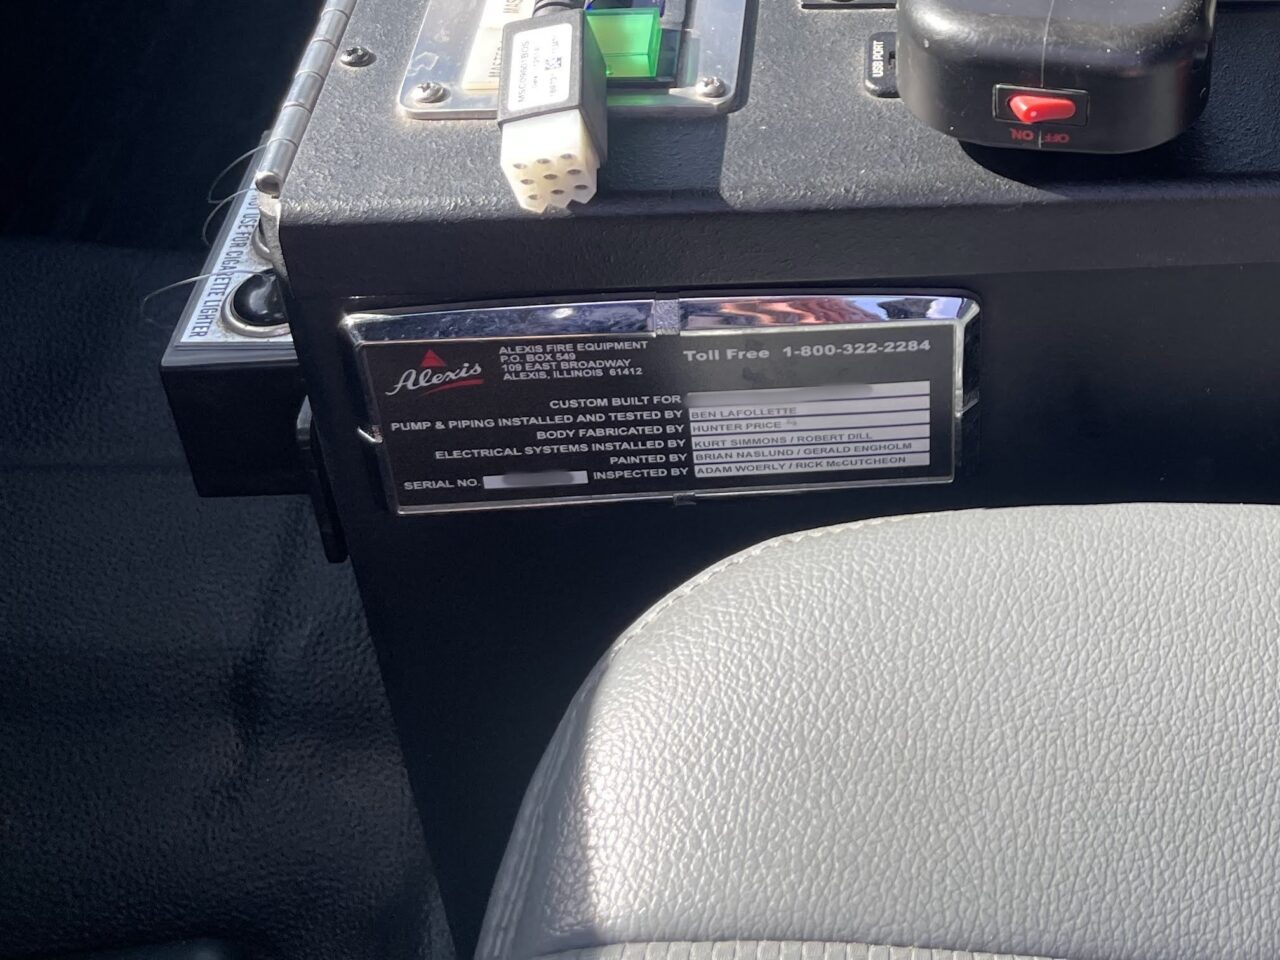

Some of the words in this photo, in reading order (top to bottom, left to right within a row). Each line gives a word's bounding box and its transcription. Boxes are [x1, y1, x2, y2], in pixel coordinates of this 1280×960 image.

[872, 40, 883, 59] PORT
[872, 61, 883, 78] USB
[207, 248, 243, 297] CIGARETTE
[189, 298, 221, 337] LIGHTER
[499, 345, 543, 354] ALEXIS
[546, 343, 574, 353] FIRE
[577, 340, 648, 351] EQUIPMENT
[683, 349, 719, 362] Toll
[726, 348, 770, 360] Free
[782, 339, 931, 358] 1-800-322-2284
[502, 363, 523, 371] 109
[525, 361, 559, 371] EAST
[562, 359, 631, 369] BROADWAY
[526, 352, 553, 362] BOX
[385, 362, 481, 396] Alexis
[503, 371, 550, 381] ALEXIS,
[553, 369, 603, 379] ILLINOIS
[609, 367, 642, 376] 61412
[550, 398, 608, 409] CUSTOM
[612, 397, 650, 407] BUILT
[654, 395, 681, 405] FOR
[391, 421, 431, 431] PUMP
[435, 419, 445, 429] &
[449, 418, 495, 429] PIPING
[498, 415, 573, 427] INSTALLED
[577, 413, 605, 422] AND
[608, 411, 661, 421] TESTED
[665, 410, 682, 419] BY
[691, 409, 716, 419] BEN
[720, 406, 797, 418] LAFOLLETTE
[536, 429, 575, 440] BODY
[578, 426, 662, 438] FABRICATED
[666, 424, 684, 433] BY
[692, 422, 742, 433] HUNTER
[745, 420, 782, 430] PRICE
[694, 439, 728, 449] KURT
[731, 436, 786, 447] SIMMONS
[797, 433, 845, 444] ROBERT
[847, 432, 872, 442] DILL
[435, 447, 522, 460] ELECTRICAL
[524, 443, 588, 455] SYSTEMS
[591, 440, 664, 452] INSTALLED
[668, 439, 685, 448] BY
[695, 451, 733, 462] BRIAN
[737, 448, 794, 459] NASLUND
[803, 445, 851, 456] GERALD
[854, 442, 912, 453] ENGHOLM
[609, 454, 665, 465] PAINTED
[669, 453, 687, 462] BY
[696, 465, 732, 475] ADAM
[735, 462, 786, 473] WOERLY
[795, 459, 823, 470] RICK
[825, 456, 906, 468] McCUTCHEON
[593, 468, 667, 480] INSPECTED
[671, 467, 688, 477] BY
[404, 480, 454, 491] SERIAL
[457, 478, 481, 489] NO.
